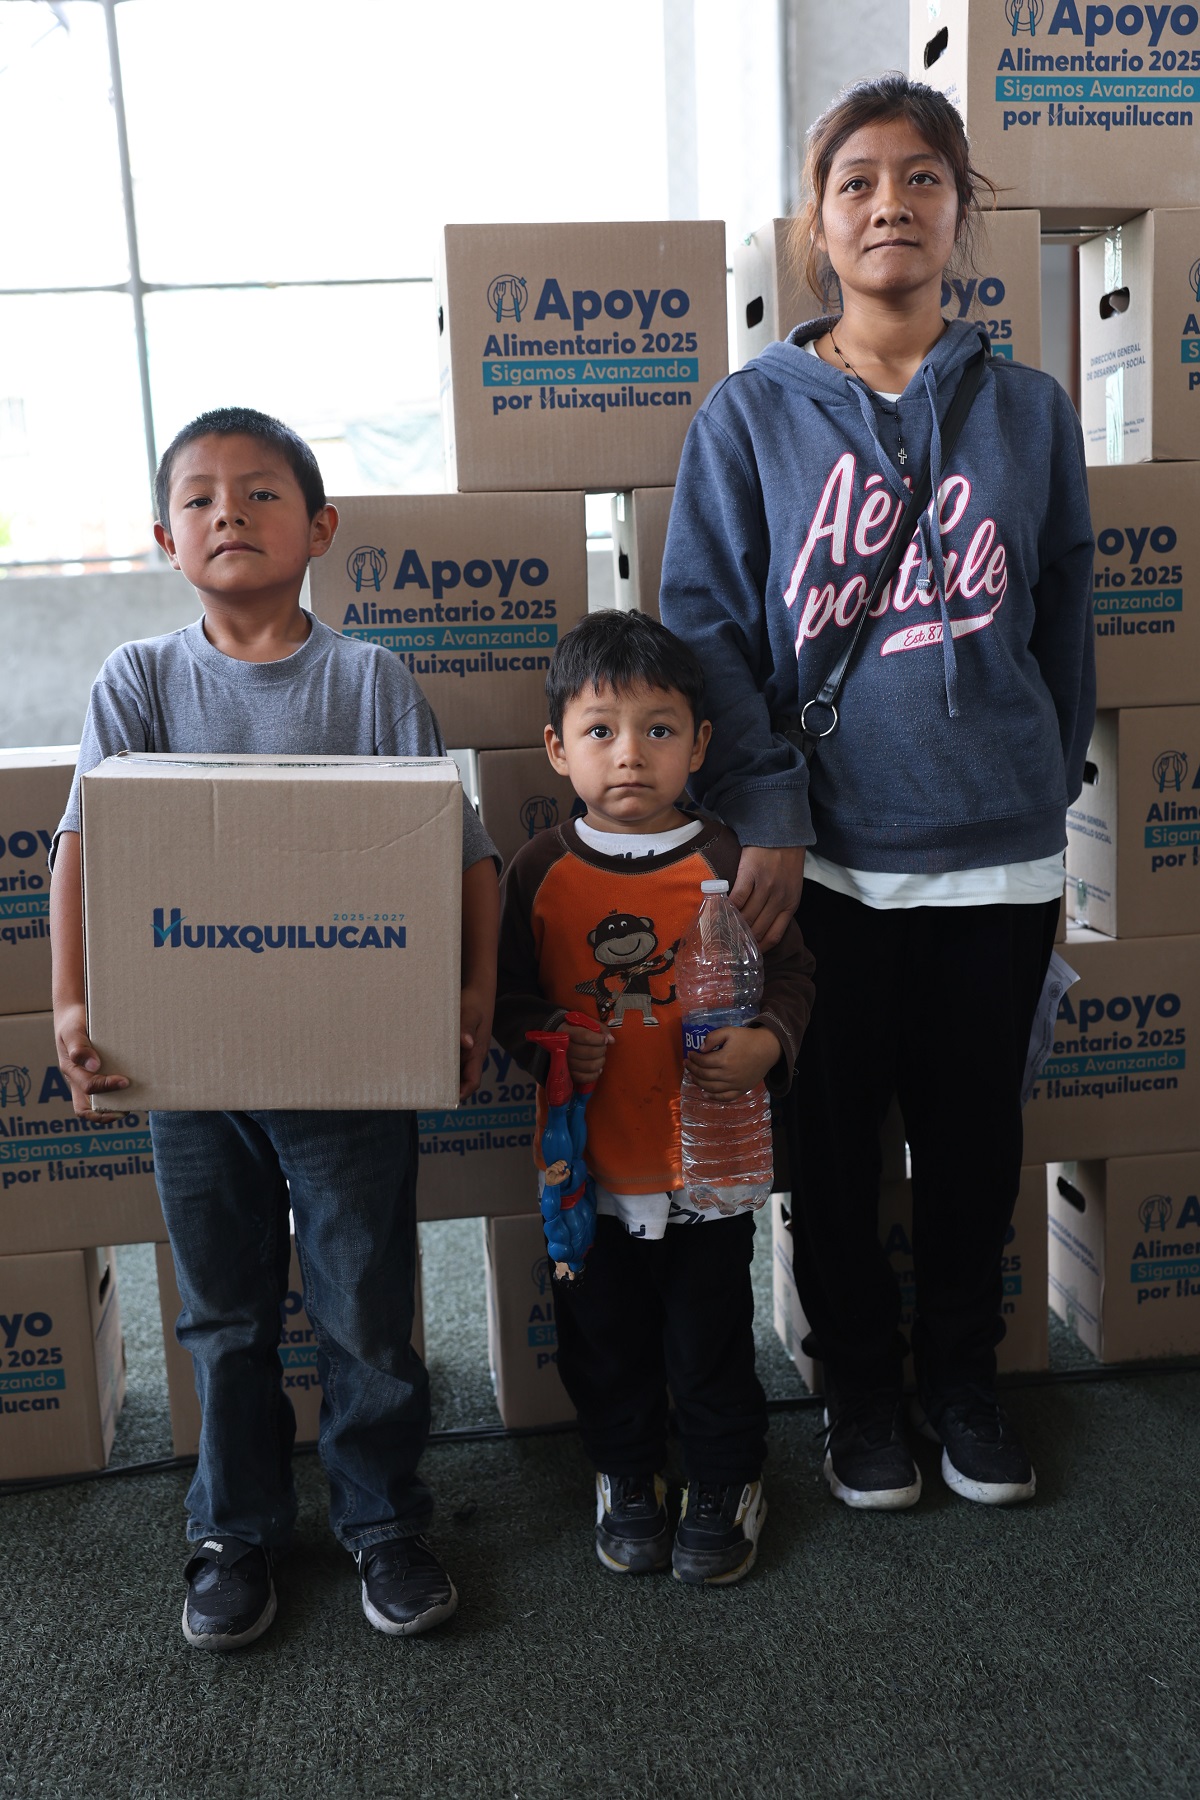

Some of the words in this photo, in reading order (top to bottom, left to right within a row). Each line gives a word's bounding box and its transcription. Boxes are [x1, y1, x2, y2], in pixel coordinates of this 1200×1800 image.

[1047, 0, 1200, 47] Apoyo
[997, 48, 1143, 72] Alimentario
[1148, 50, 1200, 72] 2025
[1003, 79, 1084, 101] Sigamos
[1090, 79, 1195, 98] Avanzando
[1003, 110, 1042, 131] por
[1047, 103, 1193, 131] Huixquilucan
[533, 278, 691, 331] Apoyo
[483, 332, 637, 357] Alimentario
[641, 332, 698, 354] 2025
[491, 364, 576, 385] Sigamos
[582, 360, 692, 381] Avanzando
[492, 394, 533, 416] por
[539, 386, 692, 413] Huixquilucan
[783, 450, 972, 608] Aéo
[393, 549, 549, 600] Apoyo
[1130, 565, 1183, 586] 2025
[342, 599, 496, 625] Alimentario
[500, 599, 558, 621] 2025
[441, 629, 551, 646] Avanzando
[1152, 853, 1187, 873] por
[333, 913, 406, 922] 2025-2027
[1137, 1028, 1187, 1048] 2025
[1085, 1052, 1180, 1073] Avanzando
[1047, 1076, 1179, 1100] Huixquilucan
[1, 1142, 83, 1161] Sigamos
[420, 1131, 535, 1156] uixquiluca
[2, 1168, 42, 1189] por
[1137, 1286, 1171, 1304] por
[8, 1347, 63, 1368] 2025
